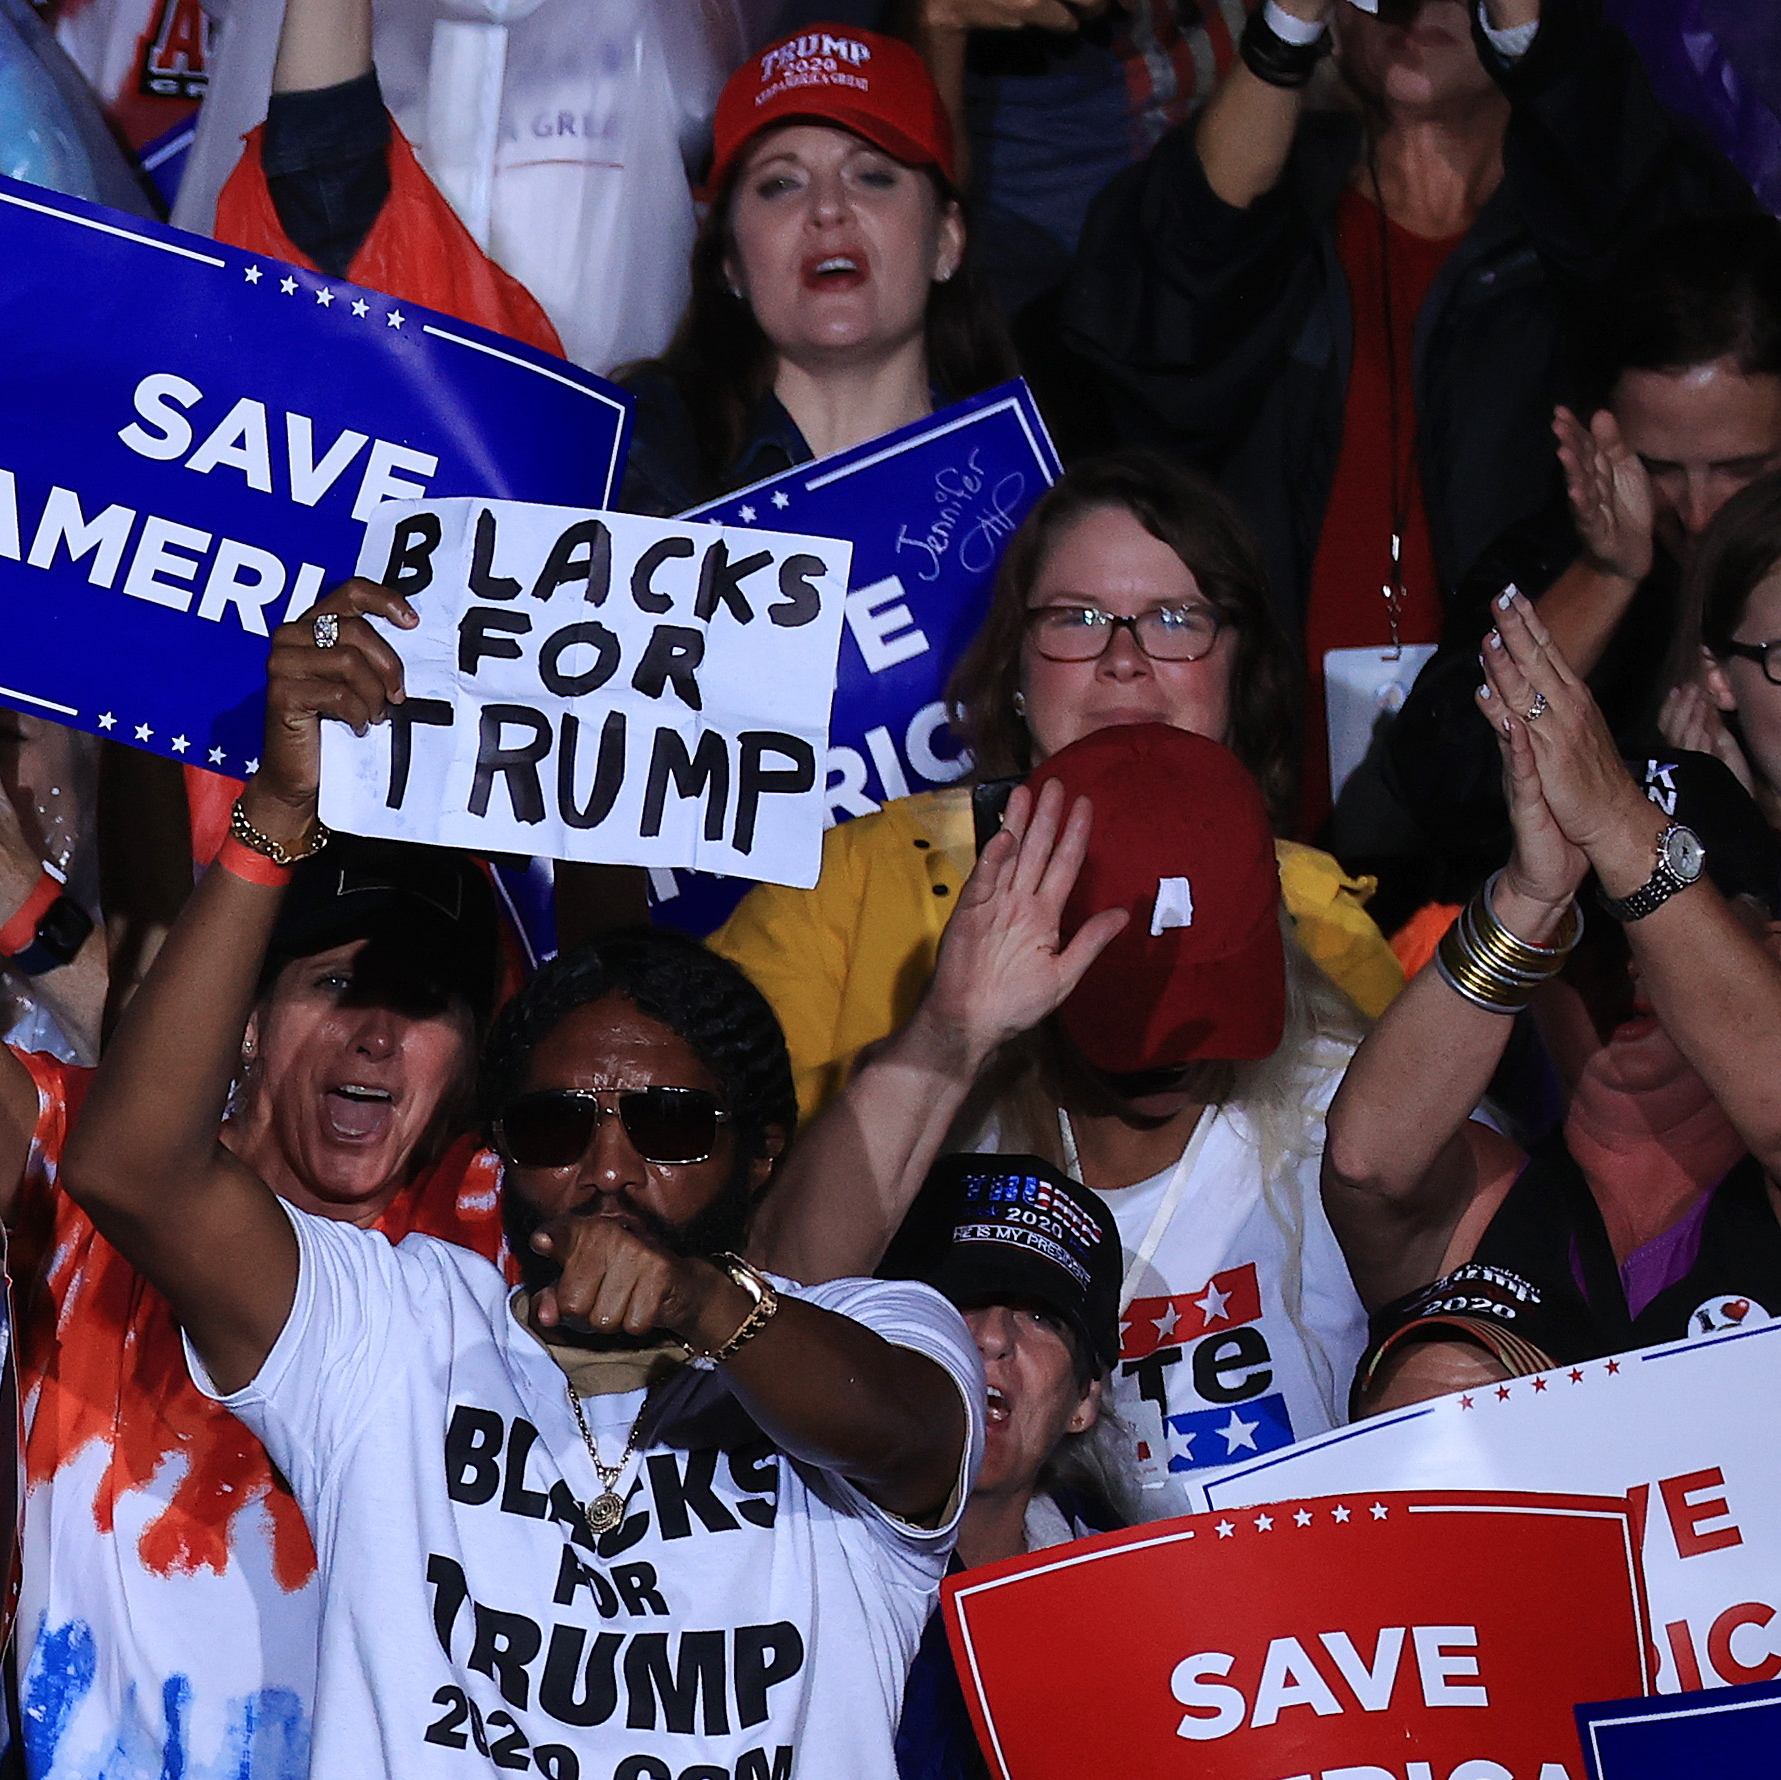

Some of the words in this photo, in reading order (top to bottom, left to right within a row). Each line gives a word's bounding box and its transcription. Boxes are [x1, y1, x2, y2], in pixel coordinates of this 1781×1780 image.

[761, 33, 871, 82] TRUMP
[117, 372, 440, 523] SAVE
[382, 507, 827, 628] BLACKS
[895, 448, 985, 582] Jennifer
[457, 607, 704, 712] FOR
[380, 699, 815, 857] TRUMP
[962, 1174, 1104, 1248] TRUMP
[976, 1224, 991, 1239] IS
[995, 1227, 1023, 1242] MY
[1005, 1206, 1064, 1240] 2020
[1420, 1296, 1517, 1320] 2020
[444, 1404, 780, 1559] BLACKS
[552, 1543, 671, 1620] FOR
[425, 1553, 805, 1737] TRUMP
[1169, 1625, 1489, 1742] SAVE
